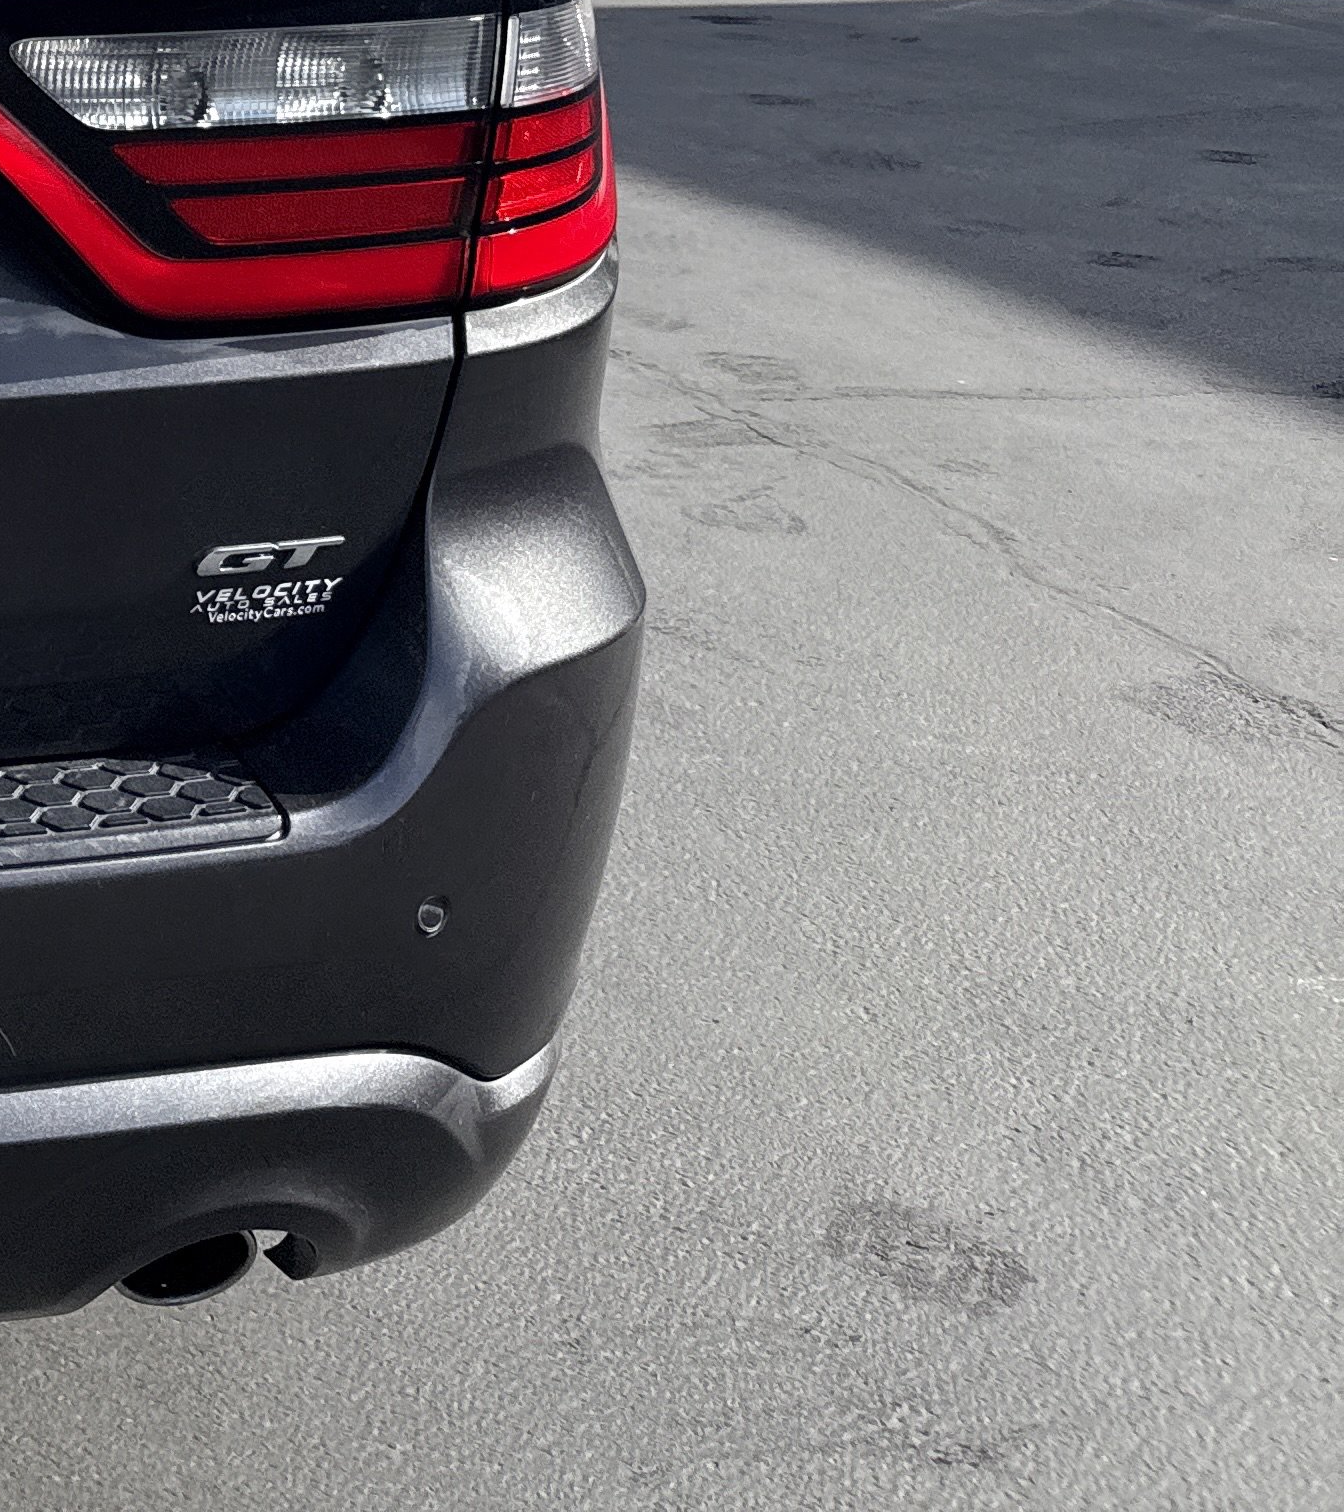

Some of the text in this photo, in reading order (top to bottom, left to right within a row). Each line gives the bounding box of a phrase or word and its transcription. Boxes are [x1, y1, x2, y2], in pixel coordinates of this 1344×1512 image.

[196, 535, 345, 577] GT
[196, 577, 343, 603] VELOCITY
[190, 591, 333, 614] AUTO SALES
[208, 603, 325, 623] VelocityCars.com
